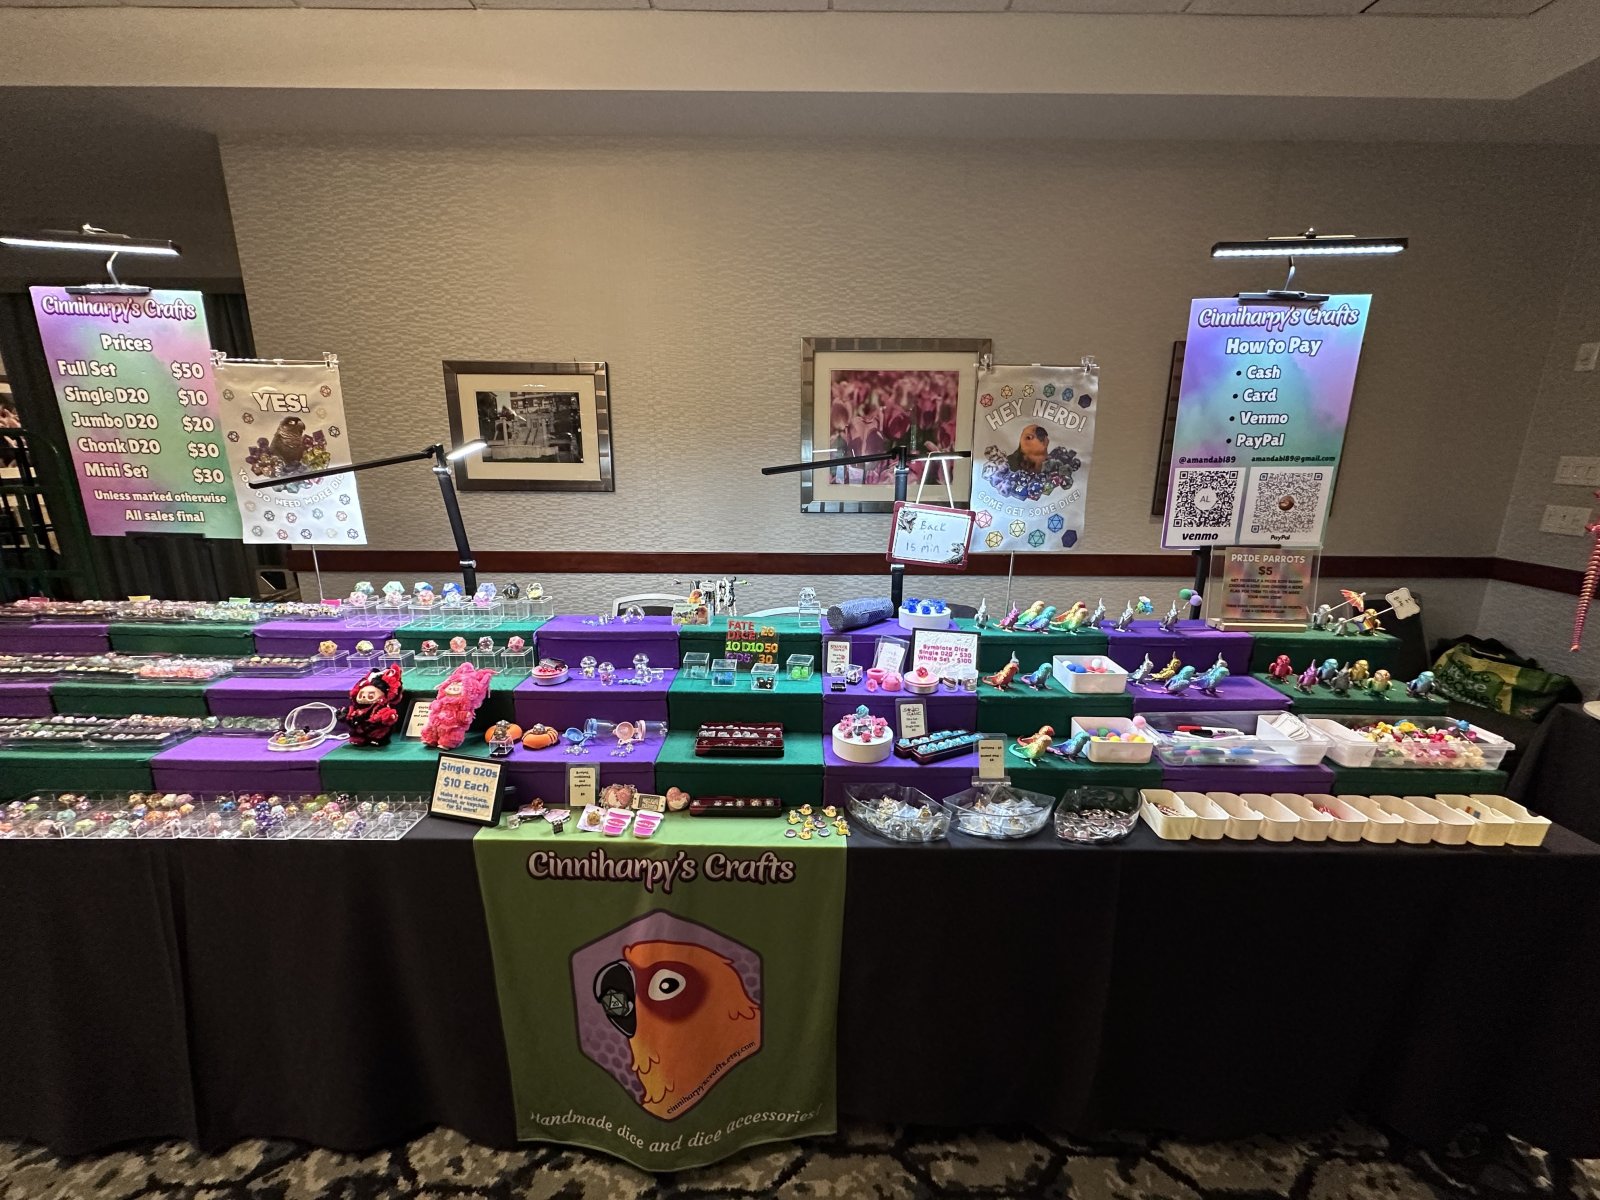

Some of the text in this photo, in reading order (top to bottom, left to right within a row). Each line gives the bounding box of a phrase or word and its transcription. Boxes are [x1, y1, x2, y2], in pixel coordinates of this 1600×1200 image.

[41, 295, 197, 322] Cinniharpy's Crafts
[1198, 303, 1360, 331] Cinniharpy's Crafts
[100, 333, 153, 352] Prices
[1225, 336, 1322, 357] How to Pay
[57, 360, 204, 380] Full Set $50
[1246, 365, 1281, 379] Cash
[65, 387, 208, 407] Single D20 $10
[251, 391, 310, 413] YES!
[1243, 388, 1278, 402] Card
[72, 413, 215, 433] Jumbo D20 $20
[985, 398, 1087, 432] HEY NERD!
[1240, 411, 1289, 425] Venmo
[77, 437, 220, 459] Chonk D20 $30
[1236, 433, 1285, 449] PayPal
[85, 463, 225, 485] Mini Set $30
[94, 490, 227, 503] Unless marked otherwise
[255, 490, 271, 502] DO
[275, 498, 301, 508] NEED
[304, 488, 332, 505] MORE
[977, 489, 1081, 517] COME GET SOME DICE!
[125, 510, 205, 522] All sales final
[923, 531, 933, 540] in
[1182, 532, 1218, 541] venmo
[906, 542, 916, 551] 15
[1231, 554, 1306, 564] PRIDE PARROTS
[1258, 566, 1273, 575] $5
[727, 626, 775, 640] DICE 20
[728, 620, 754, 630] FATE
[726, 641, 778, 653] 10 D10 50
[759, 655, 773, 664] 30
[441, 762, 497, 778] Single D20s
[443, 776, 489, 792] $10 Each
[467, 801, 489, 809] keychain
[527, 850, 795, 893] Cinniharpy's Crafts
[667, 1041, 756, 1114] cinniharpyscrafts.etsy.com
[531, 1104, 822, 1152] Handmade dice and dice accessories!
